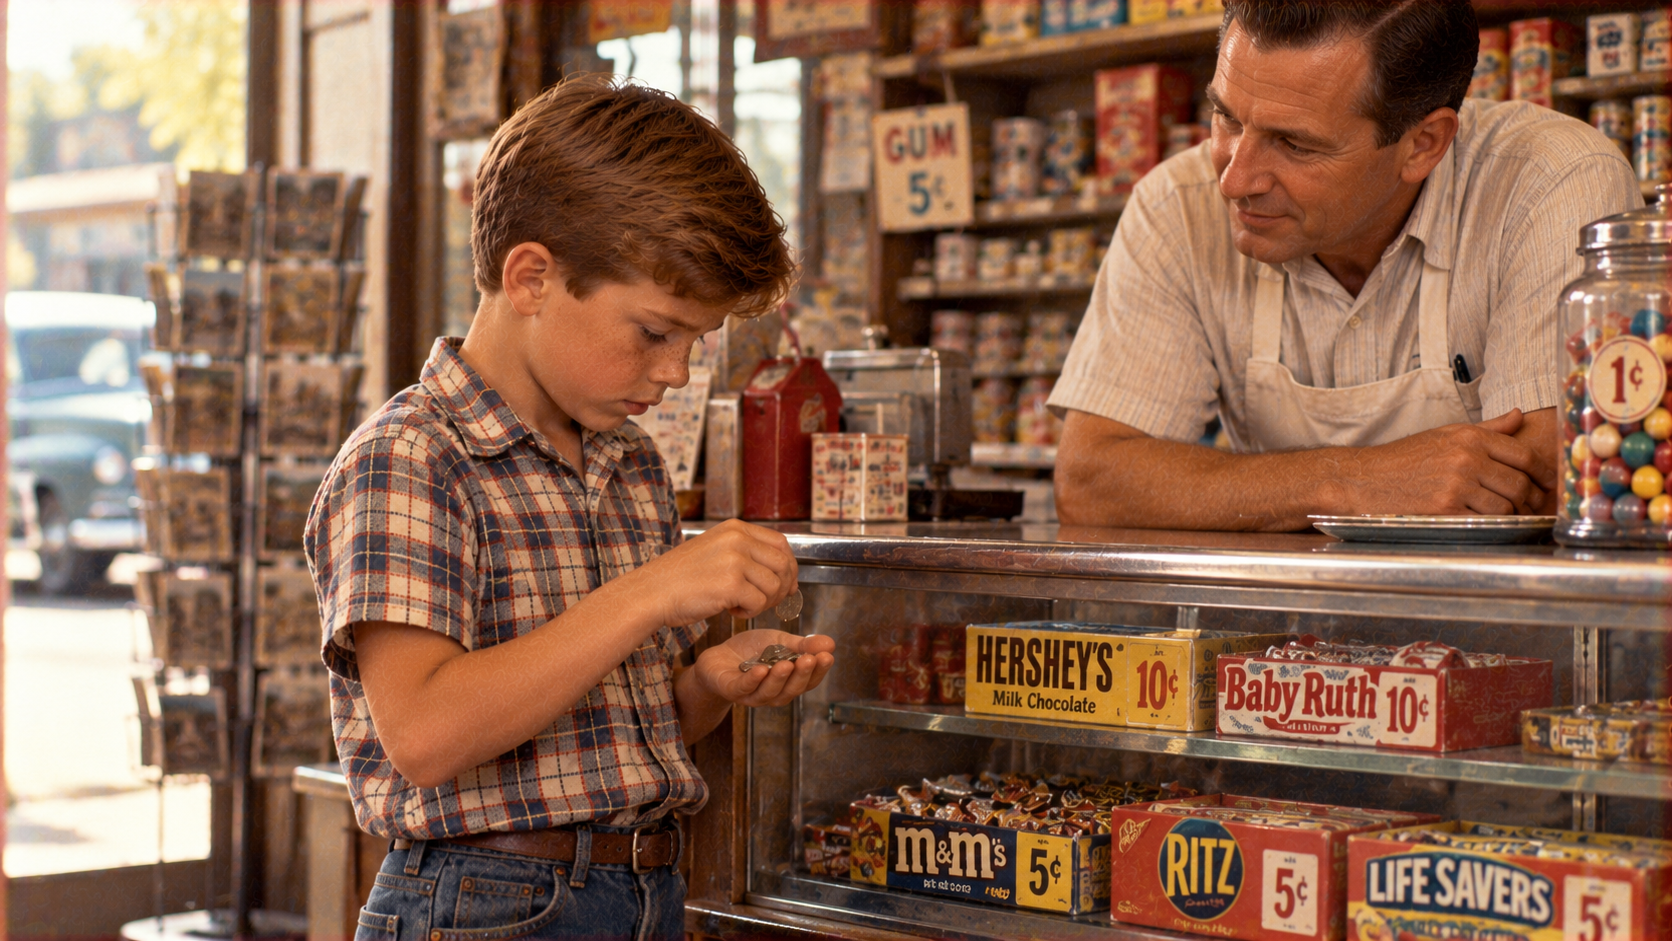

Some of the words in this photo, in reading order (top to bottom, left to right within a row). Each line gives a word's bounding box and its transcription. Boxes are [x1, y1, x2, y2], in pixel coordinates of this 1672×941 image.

[883, 121, 957, 164] GUM
[1611, 356, 1643, 404] 1¢
[976, 635, 1113, 692] HERSHEY'S
[1136, 660, 1178, 710] 10¢
[992, 690, 1022, 708] Milk
[1027, 692, 1096, 714] Chocolate
[1224, 666, 1300, 722] Baby
[1302, 671, 1377, 719] Ruth
[1386, 685, 1429, 734] 10¢
[1029, 847, 1061, 896] 5¢
[1167, 833, 1235, 897] RITZ
[1274, 867, 1308, 919] 5¢
[1370, 857, 1430, 904] LIFE
[1435, 859, 1550, 923] SAVERS
[1579, 894, 1619, 941] 5¢
